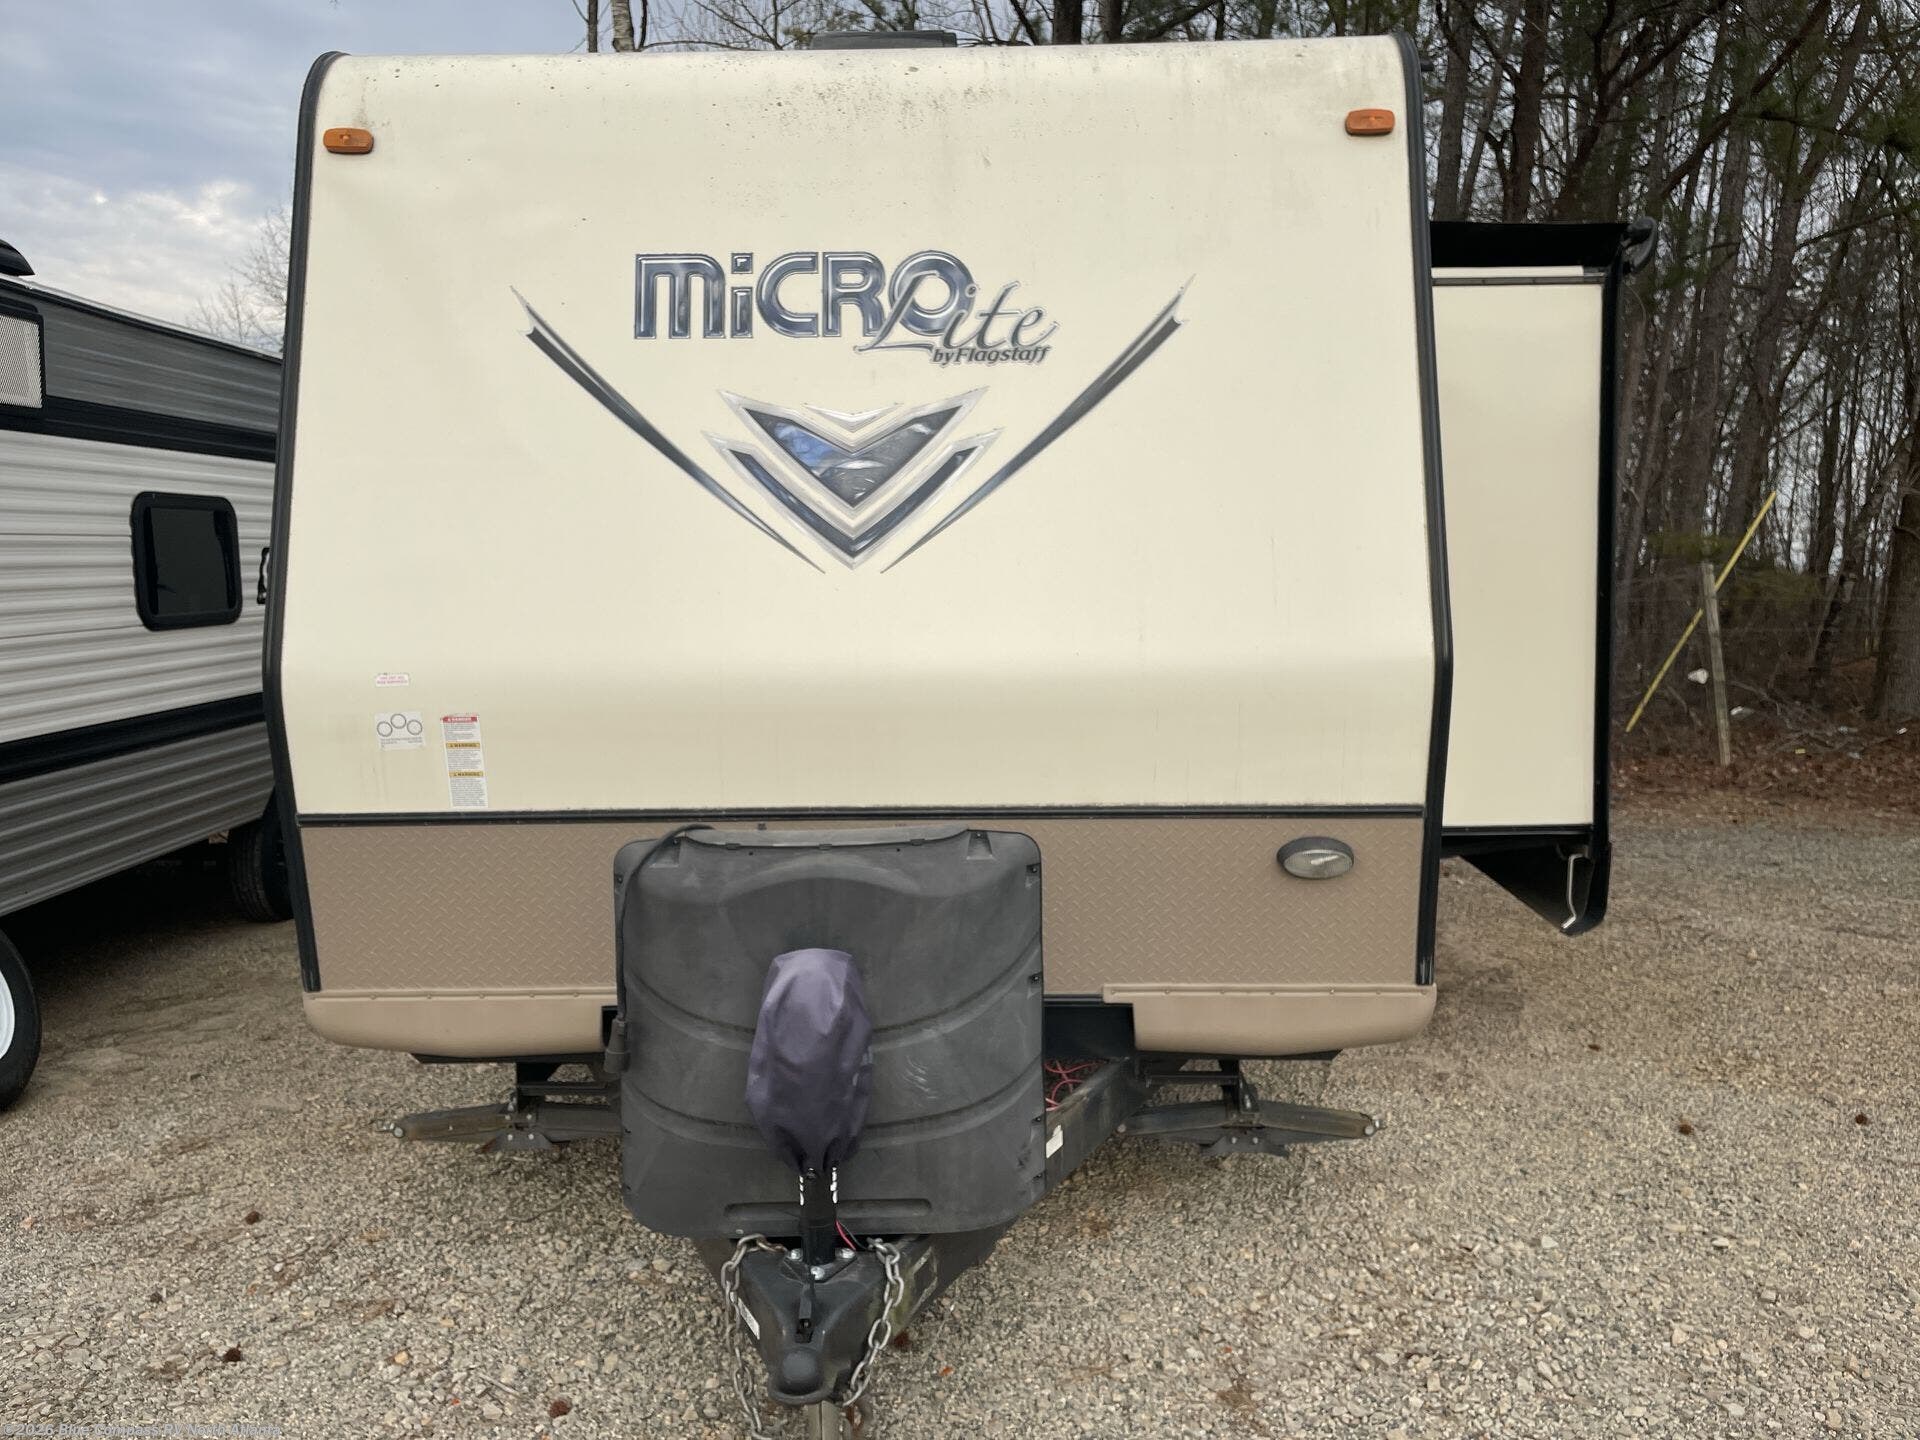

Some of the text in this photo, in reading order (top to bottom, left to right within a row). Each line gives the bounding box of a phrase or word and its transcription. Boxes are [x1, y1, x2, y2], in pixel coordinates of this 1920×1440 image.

[853, 268, 1060, 355] Lite
[932, 346, 1051, 367] by Flagstaff
